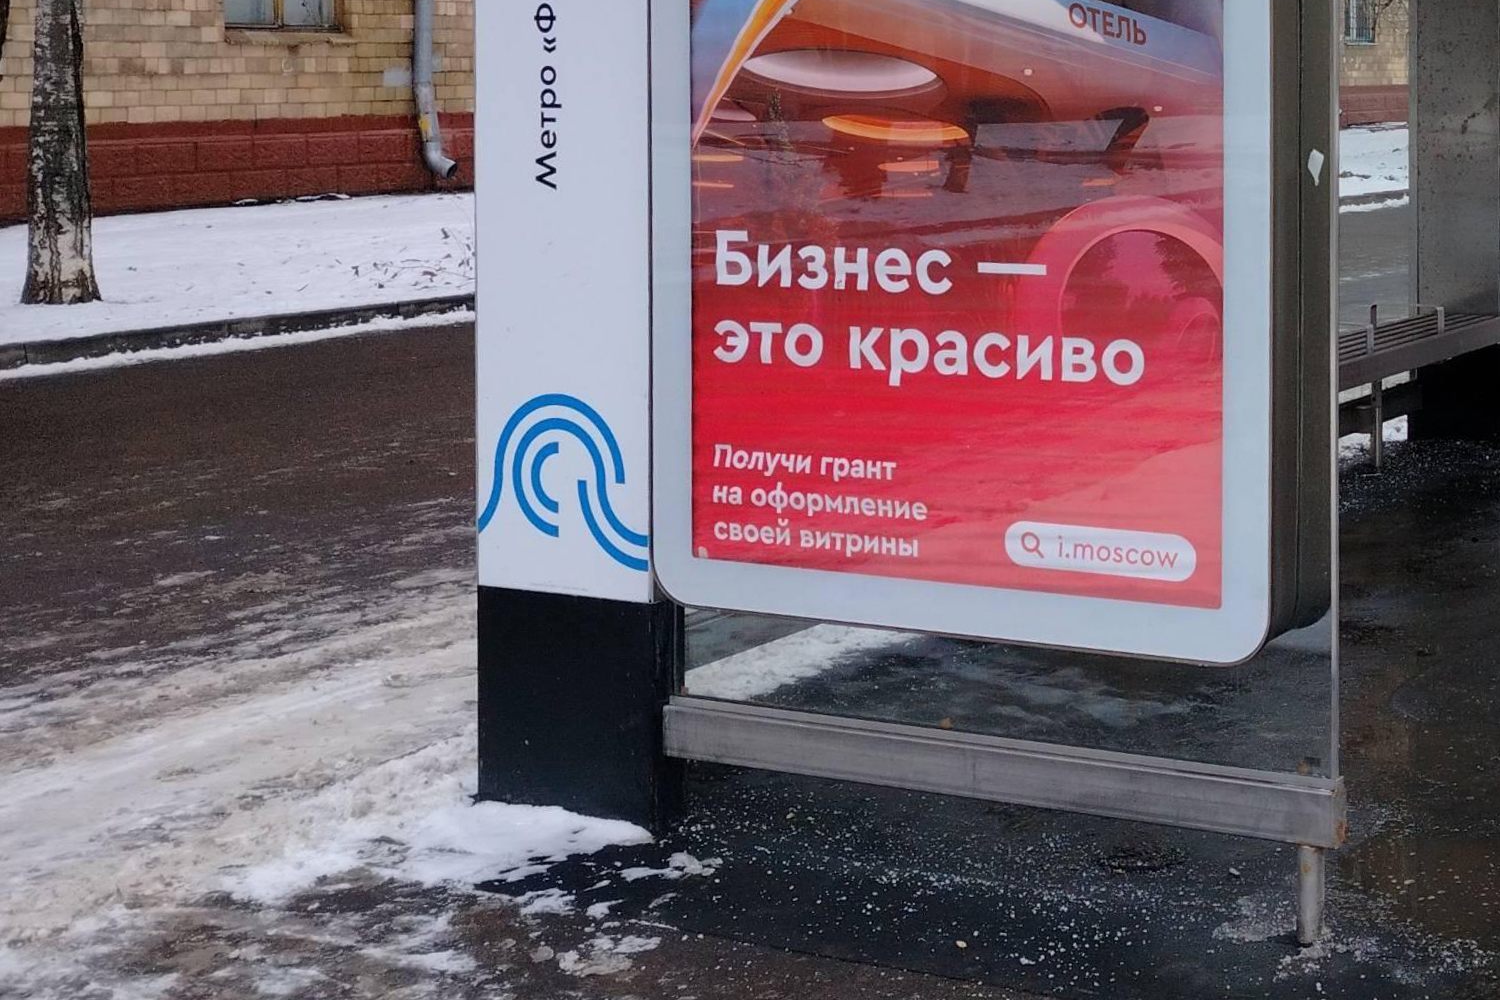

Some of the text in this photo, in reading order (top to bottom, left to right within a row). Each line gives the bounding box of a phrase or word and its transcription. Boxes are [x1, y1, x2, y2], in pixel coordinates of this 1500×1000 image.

[1068, 2, 1147, 46] ОТЕЛЬ
[534, 65, 562, 190] Метро
[714, 229, 953, 295] Бизнес
[713, 319, 1145, 387] это красиво
[712, 443, 897, 482] Получи грант
[712, 481, 929, 521] на оформление
[713, 518, 919, 558] своей витрины
[1057, 535, 1178, 569] i.moscow
